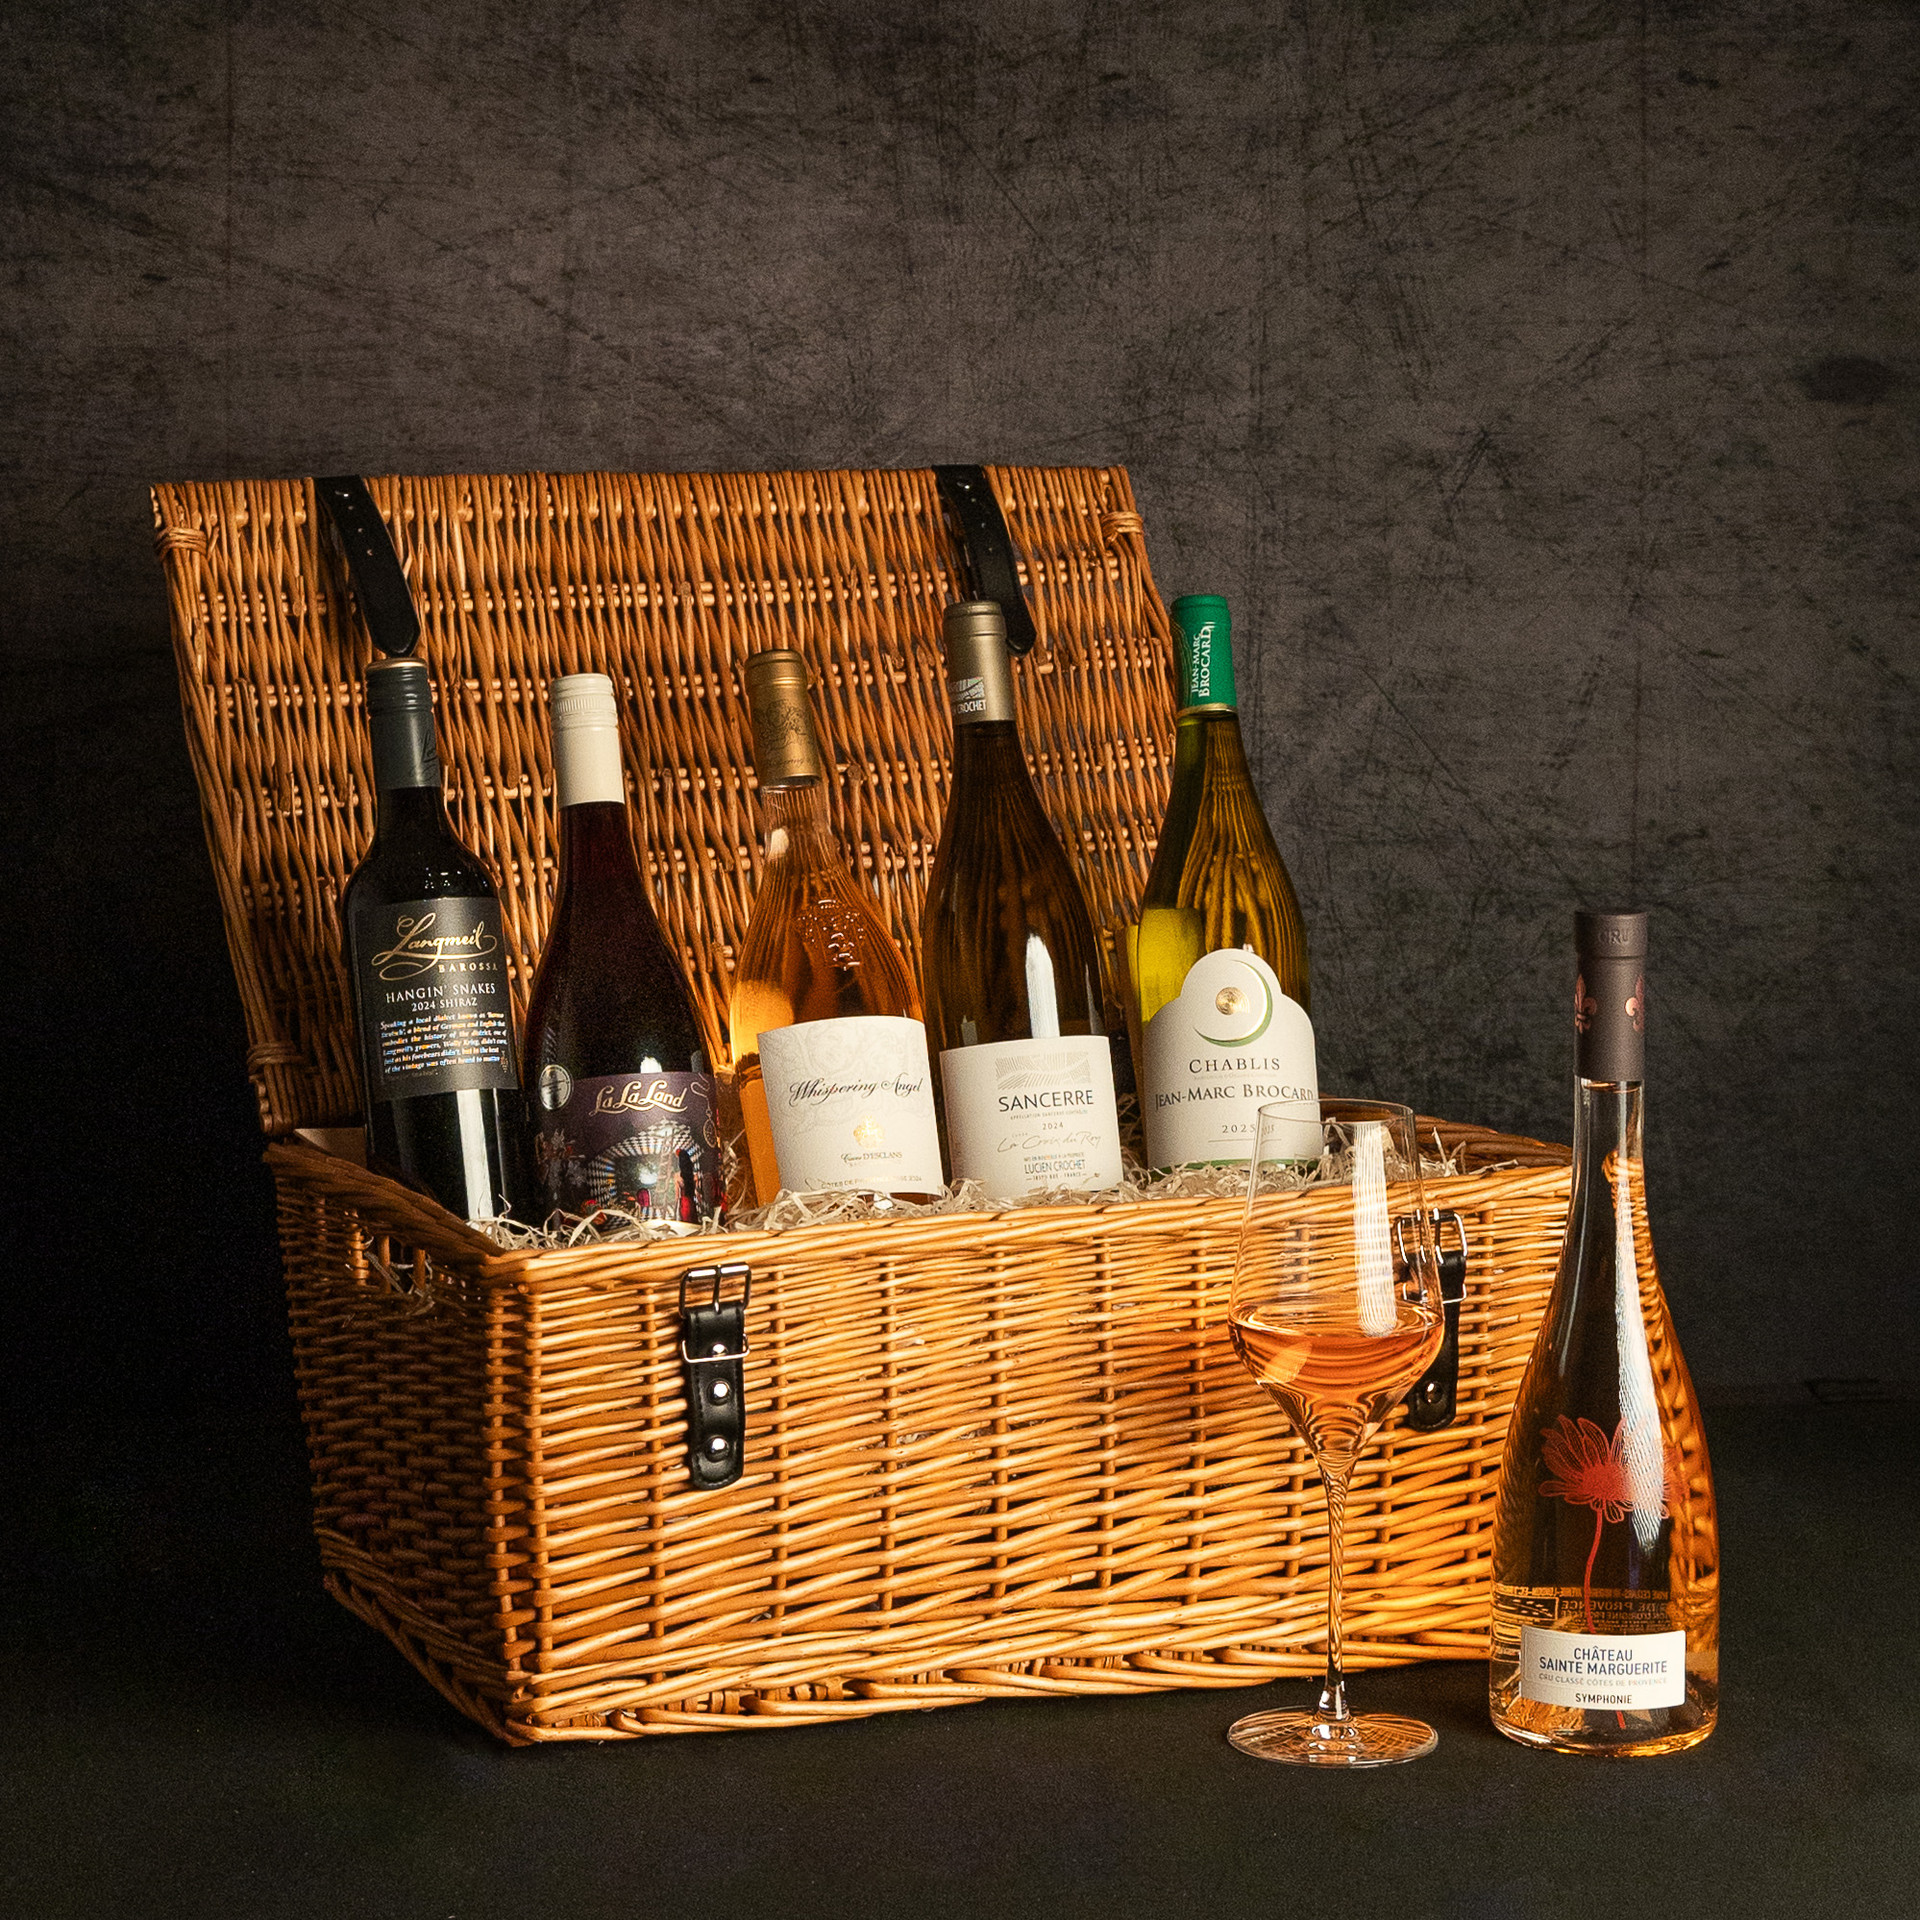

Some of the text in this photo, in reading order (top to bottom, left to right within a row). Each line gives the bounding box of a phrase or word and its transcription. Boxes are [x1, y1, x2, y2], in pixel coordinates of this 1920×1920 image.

[1191, 633, 1201, 693] JEAN-MARC
[1198, 622, 1215, 697] BROCARD
[371, 912, 498, 981] Langmeil
[438, 962, 498, 974] BAROSSA
[385, 983, 496, 1003] HANGIN' SNAKES
[411, 997, 478, 1012] 2024 SHIRAZ
[1189, 1058, 1281, 1074] CHABLIS
[588, 1084, 615, 1117] La
[639, 1079, 688, 1113] Land
[789, 1072, 924, 1107] Whispering Angel
[1155, 1083, 1314, 1113] JEAN-MARC BROCARD
[998, 1089, 1095, 1113] SANCERRE
[1042, 1121, 1064, 1131] 2024
[1024, 1159, 1086, 1175] LUCIEN CROCHET
[1573, 1645, 1633, 1662] CHÂTEAU
[1539, 1656, 1668, 1676] SAINTE MARGUERITE
[1539, 1672, 1554, 1682] CRU
[1615, 1678, 1626, 1687] DE
[1574, 1692, 1633, 1705] SYMPHONIE
